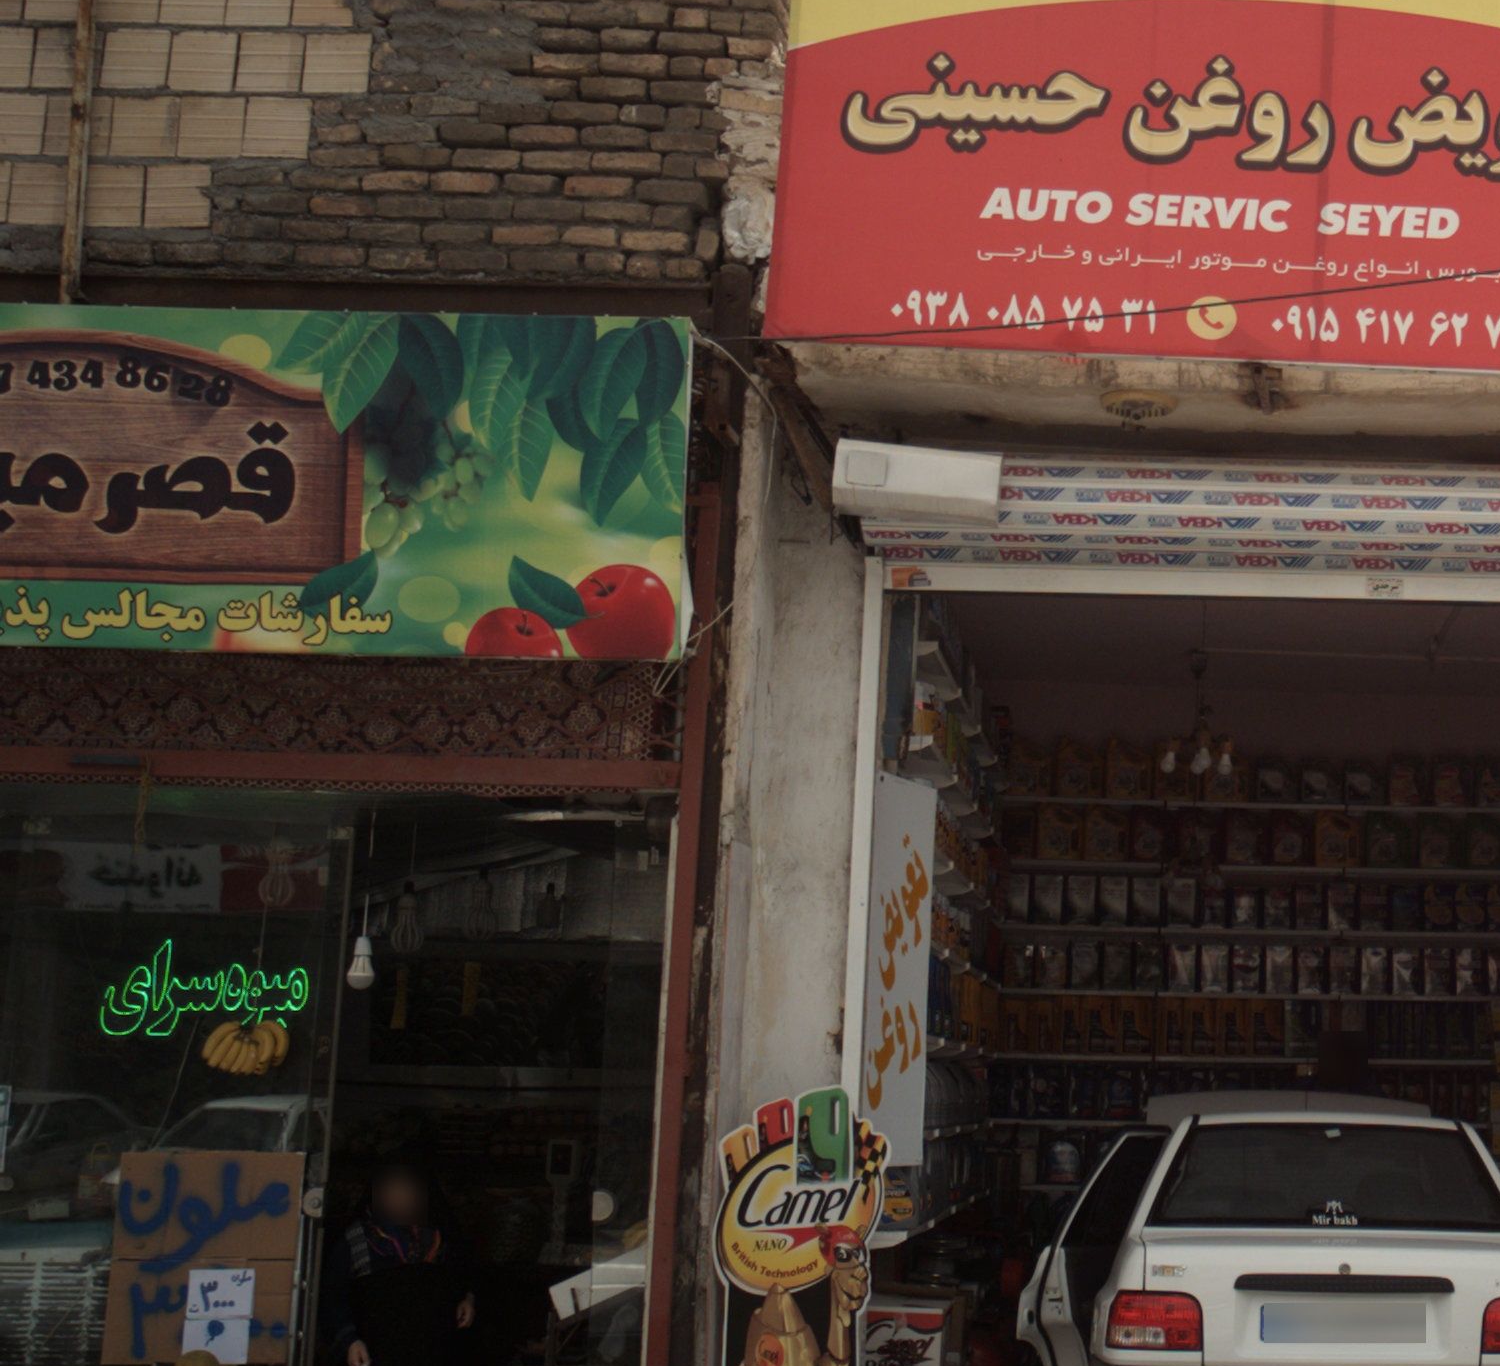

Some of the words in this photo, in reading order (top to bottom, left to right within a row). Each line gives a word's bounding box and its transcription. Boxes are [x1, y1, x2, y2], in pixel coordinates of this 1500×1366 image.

[841, 52, 1110, 154] حسینی
[1122, 55, 1335, 171] روغن
[980, 187, 1114, 224] AUTO
[1124, 192, 1292, 233] SERVIC
[1318, 203, 1461, 239] SEYED
[976, 240, 1076, 265] خارجی
[1081, 248, 1094, 266] و
[1097, 246, 1182, 267] ایرانی
[1188, 249, 1267, 272] موتور
[1272, 254, 1349, 276] روغن
[1353, 259, 1420, 282] انواع
[891, 292, 970, 328] ۰۹۳۸
[986, 294, 1043, 333] ۰۸۵
[1061, 297, 1104, 335] ۷۵
[1121, 299, 1158, 335] ۳۱
[1271, 307, 1340, 344] ۰۹۱۵
[1426, 312, 1468, 349] ۶۲
[27, 358, 105, 392] 434
[116, 356, 170, 393] 86
[177, 374, 234, 407] 28
[93, 421, 296, 535] قصر
[61, 588, 205, 642] مجالس
[218, 590, 392, 645] سفارشات
[878, 833, 930, 991] تعویض
[867, 996, 927, 1112] روغن
[119, 1162, 291, 1275] ملون
[737, 1163, 860, 1230] Camel
[730, 1241, 758, 1272] British
[759, 1258, 819, 1280] Technology
[752, 1237, 788, 1253] NANO
